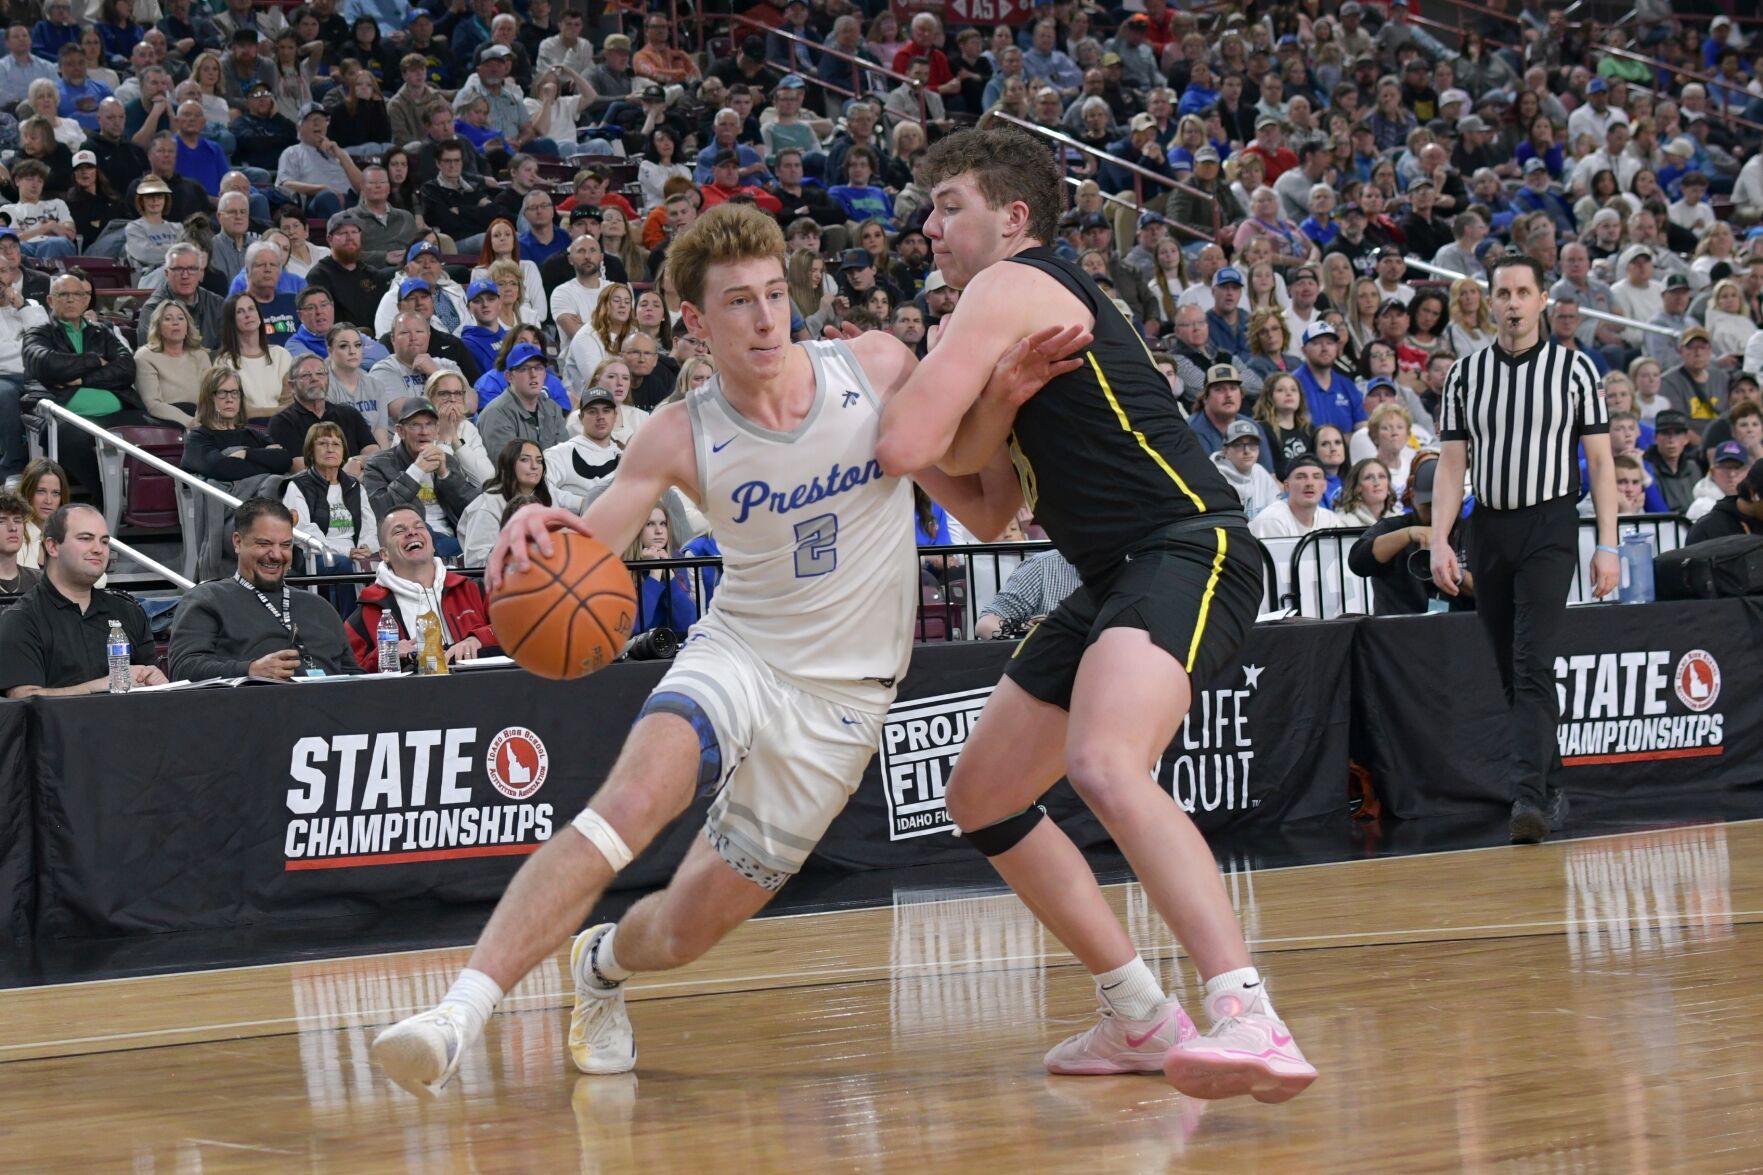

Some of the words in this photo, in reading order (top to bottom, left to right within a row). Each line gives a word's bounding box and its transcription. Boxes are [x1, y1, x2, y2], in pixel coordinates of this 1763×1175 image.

[731, 459, 884, 523] Preston
[793, 512, 839, 579] 2
[1183, 689, 1252, 750] LIFE
[1556, 713, 1724, 757] HAMPIONSHIPS
[286, 727, 477, 814] STATE
[1172, 751, 1255, 813] QUIT
[284, 803, 554, 858] CHAMPIONSHIPS
[896, 814, 933, 831] IDAHO
